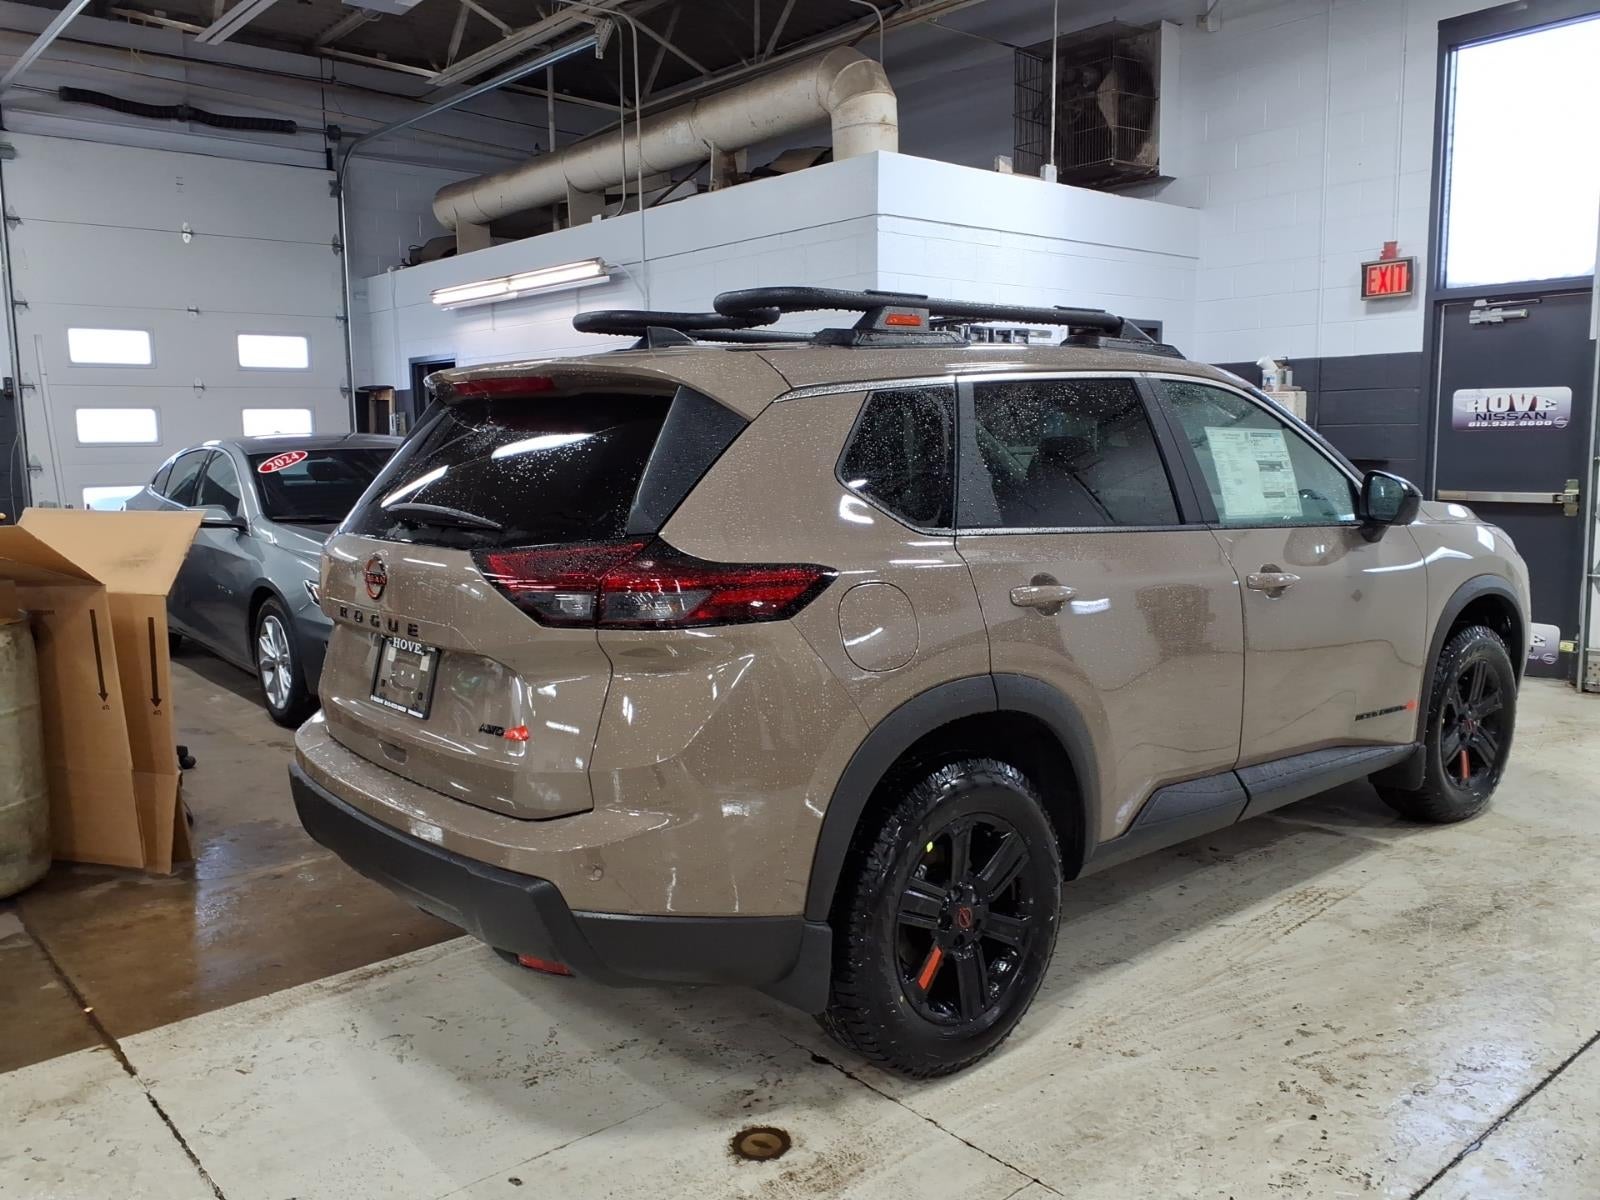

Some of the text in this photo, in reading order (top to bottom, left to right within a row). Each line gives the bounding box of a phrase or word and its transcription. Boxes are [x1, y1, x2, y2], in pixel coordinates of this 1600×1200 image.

[1368, 263, 1407, 293] EXIT
[1466, 393, 1558, 412] HOVE
[1475, 411, 1548, 421] NISSAN
[266, 452, 300, 470] 2024
[339, 606, 419, 638] ROGUE
[392, 636, 423, 654] HOVE
